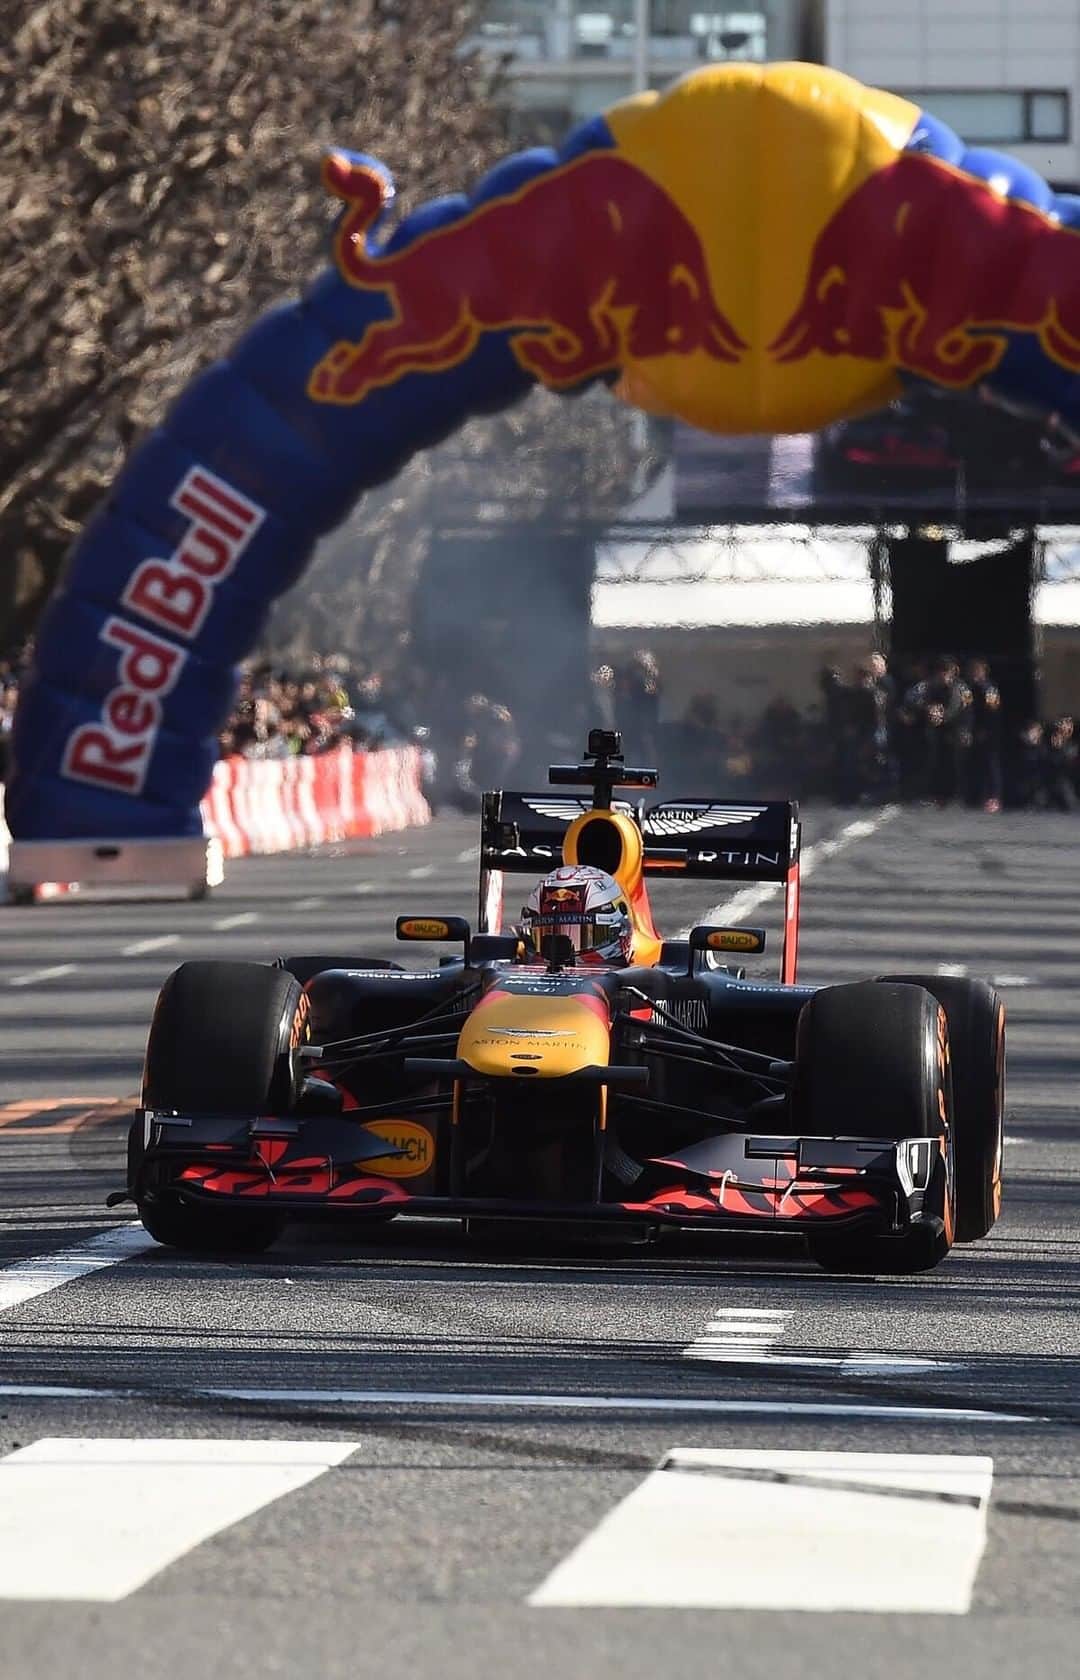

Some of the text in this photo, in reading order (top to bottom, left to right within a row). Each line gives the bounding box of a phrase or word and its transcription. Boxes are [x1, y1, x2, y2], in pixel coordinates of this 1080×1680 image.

[61, 465, 267, 795] Red Bull
[650, 809, 695, 821] MARTIN
[697, 851, 779, 865] RTIN
[558, 913, 593, 924] MARTIN
[721, 935, 752, 945] RAUCH
